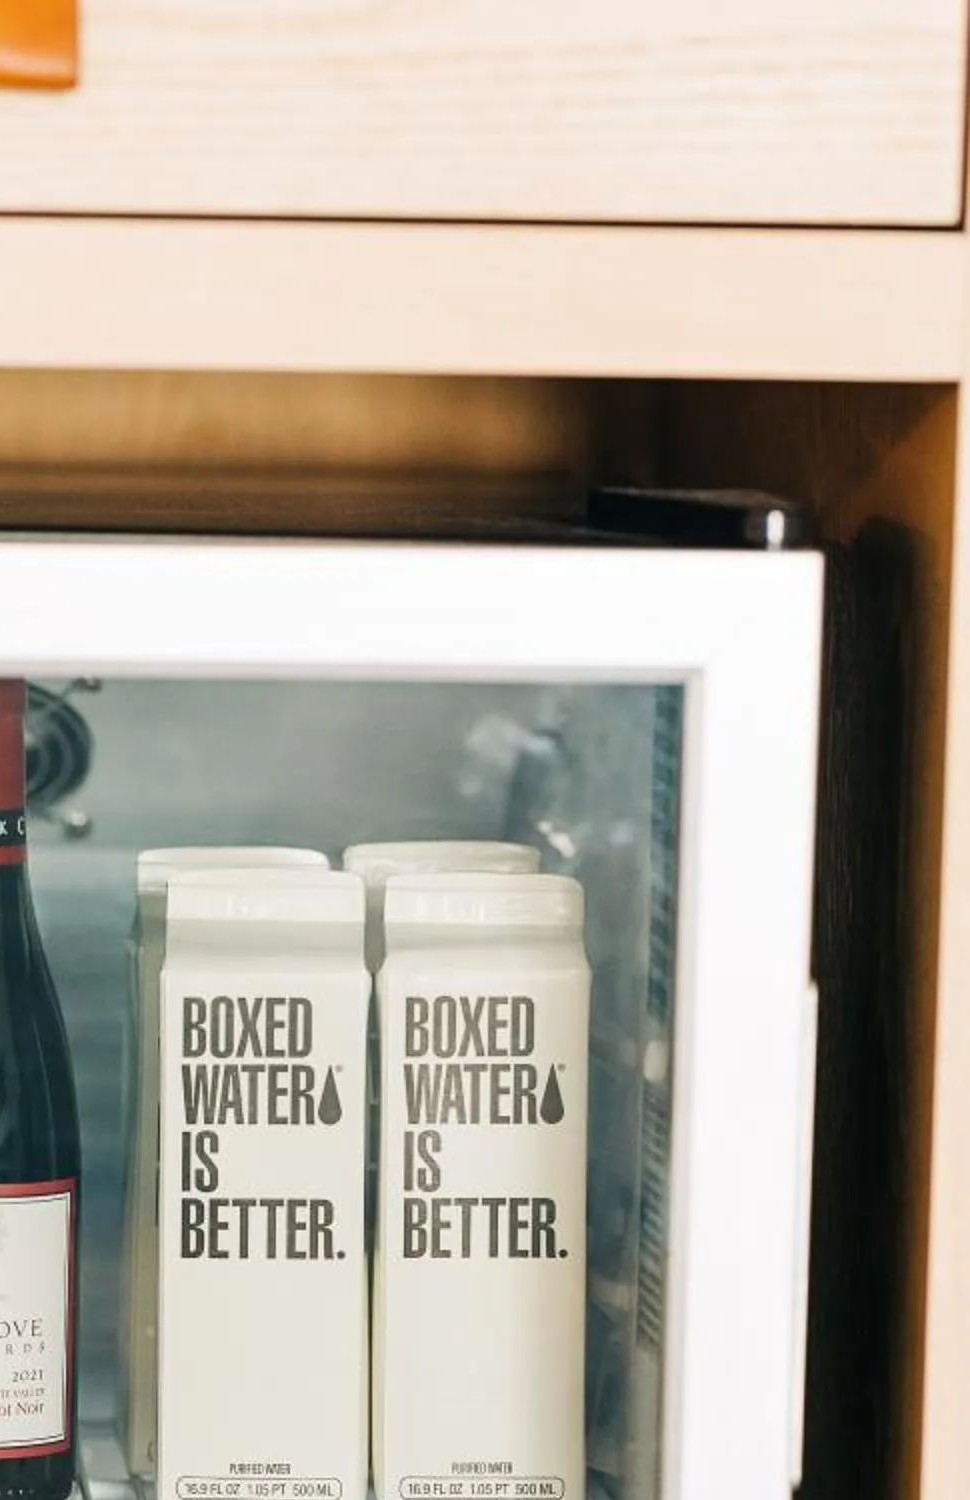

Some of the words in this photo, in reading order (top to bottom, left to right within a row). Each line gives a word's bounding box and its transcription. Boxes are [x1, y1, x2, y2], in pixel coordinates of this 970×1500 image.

[182, 996, 313, 1058] BOXED
[405, 995, 535, 1058] BOXED
[181, 1064, 316, 1125] WATER
[404, 1063, 538, 1125] WATER
[181, 1130, 219, 1192] IS
[403, 1130, 442, 1192] IS
[180, 1198, 346, 1259] BETTER.
[403, 1197, 568, 1259] BETTER.
[12, 1368, 43, 1382] 2021
[16, 1401, 45, 1416] Noir
[210, 1483, 223, 1495] FL
[271, 1484, 286, 1496] PT
[293, 1484, 315, 1497] 500
[316, 1484, 335, 1497] ML
[408, 1483, 431, 1495] 16.9
[433, 1483, 446, 1495] FL
[495, 1483, 510, 1495] PT
[539, 1483, 556, 1495] ML
